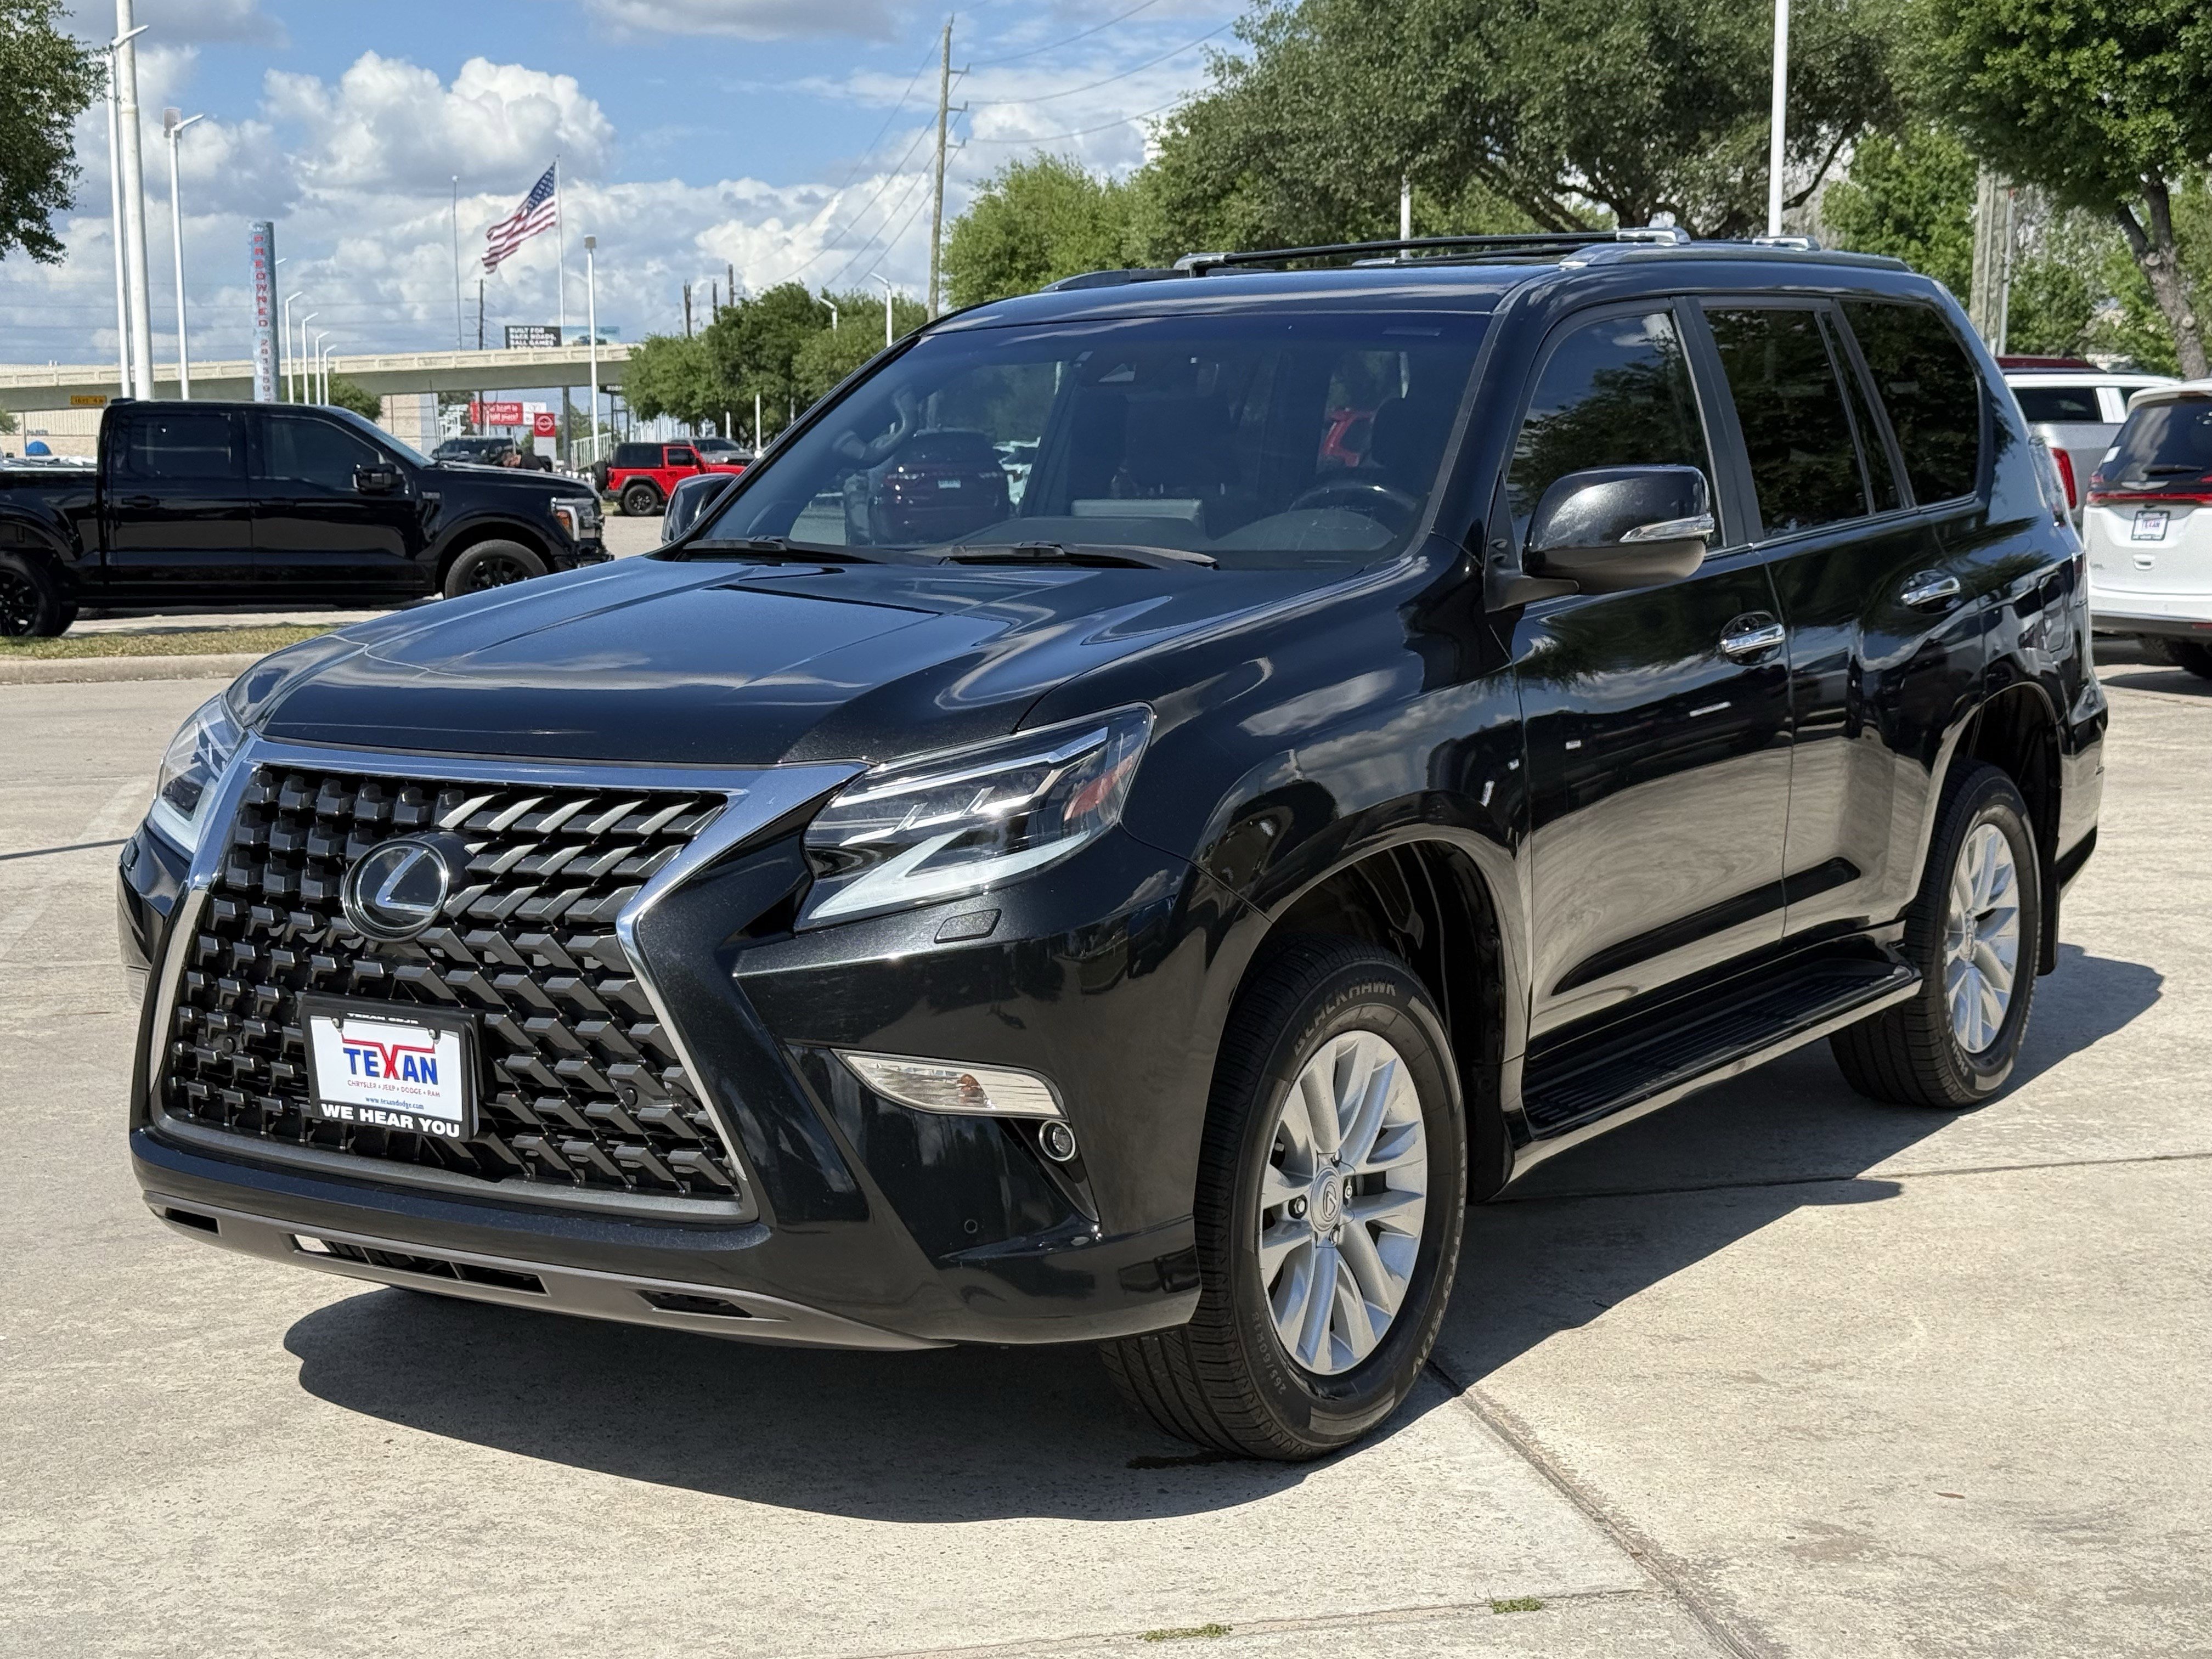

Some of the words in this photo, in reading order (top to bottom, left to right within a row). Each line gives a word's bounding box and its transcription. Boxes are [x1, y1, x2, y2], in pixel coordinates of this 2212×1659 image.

[1291, 979, 1396, 1057] BLACKHAWK
[342, 1042, 438, 1085] TEXAN
[347, 1080, 376, 1089] CHRYSLER
[401, 1086, 421, 1094] DODGE
[365, 1097, 424, 1109] www.texandodge.com
[321, 1103, 354, 1120] WE
[360, 1108, 414, 1130] HEAR
[418, 1117, 460, 1138] YOU
[1252, 1312, 1286, 1395] 265/60R18
